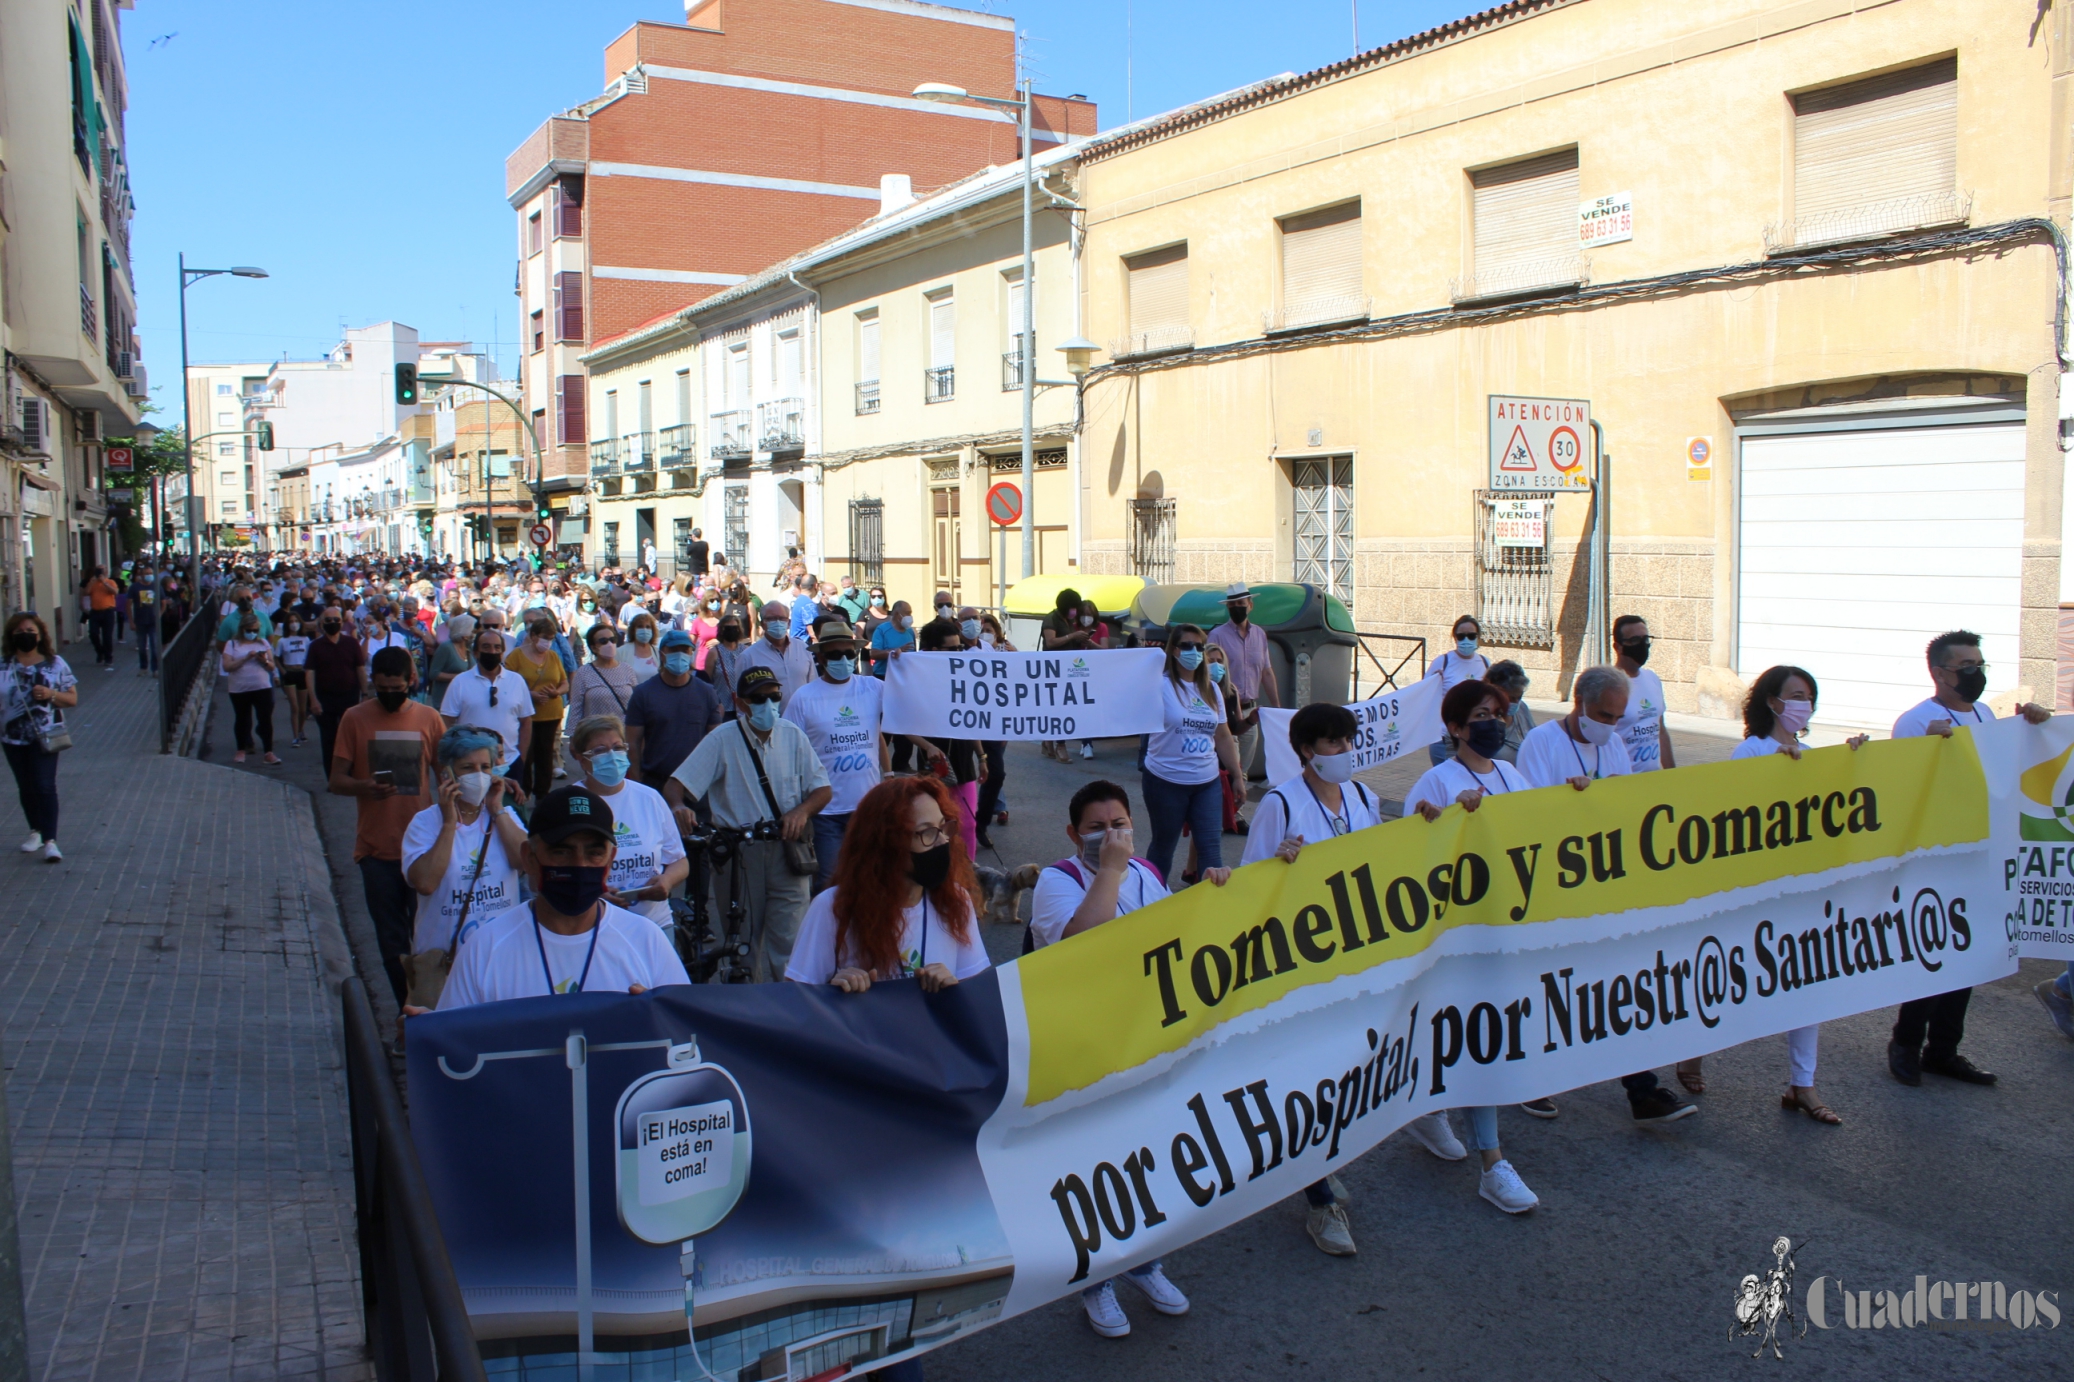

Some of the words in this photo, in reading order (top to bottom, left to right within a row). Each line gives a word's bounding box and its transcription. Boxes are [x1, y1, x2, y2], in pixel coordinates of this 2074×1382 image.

[1581, 203, 1631, 220] VENDE
[1596, 197, 1614, 208] SE
[1580, 222, 1595, 241] 689
[1597, 219, 1607, 237] 63
[1609, 216, 1618, 235] 31
[1621, 213, 1631, 231] 56
[1497, 402, 1584, 423] ATENCIÓN
[111, 449, 128, 463] Q
[1556, 441, 1574, 457] 30
[1495, 475, 1526, 488] ZONA
[1497, 511, 1542, 520] VENDE
[1511, 502, 1527, 511] SE
[1496, 521, 1509, 538] 689
[1511, 521, 1519, 538] 63
[1521, 521, 1530, 538] 31
[1532, 521, 1542, 538] 56
[745, 670, 773, 682] ITALIA
[949, 658, 1008, 679] POR
[1026, 659, 1061, 679] UN
[950, 679, 1096, 707] HOSPITAL
[949, 708, 991, 729] CON
[1002, 715, 1076, 735] FUTURO
[830, 729, 870, 745] Hospital
[824, 744, 851, 754] General
[833, 753, 873, 773] 100%
[611, 852, 655, 873] ospital
[1143, 852, 1490, 1029] Tomelloso
[1506, 843, 1542, 922] y
[1556, 828, 1626, 889] su
[1638, 786, 1882, 872] Comarca
[2032, 897, 2056, 928] DE
[2060, 899, 2074, 928] T
[1049, 1146, 1167, 1285] por
[1171, 1092, 1235, 1208] el
[1222, 1000, 1420, 1182] Hospital,
[1430, 995, 1531, 1097] por
[1541, 935, 1748, 1054] Nuestr@s
[1755, 885, 1973, 998] Sanitari@s
[643, 1121, 664, 1147] ¡El
[668, 1110, 731, 1138] Hospital
[660, 1138, 690, 1163] está
[694, 1138, 713, 1154] en
[664, 1157, 707, 1185] coma!
[719, 1257, 802, 1284] HOSPITAL
